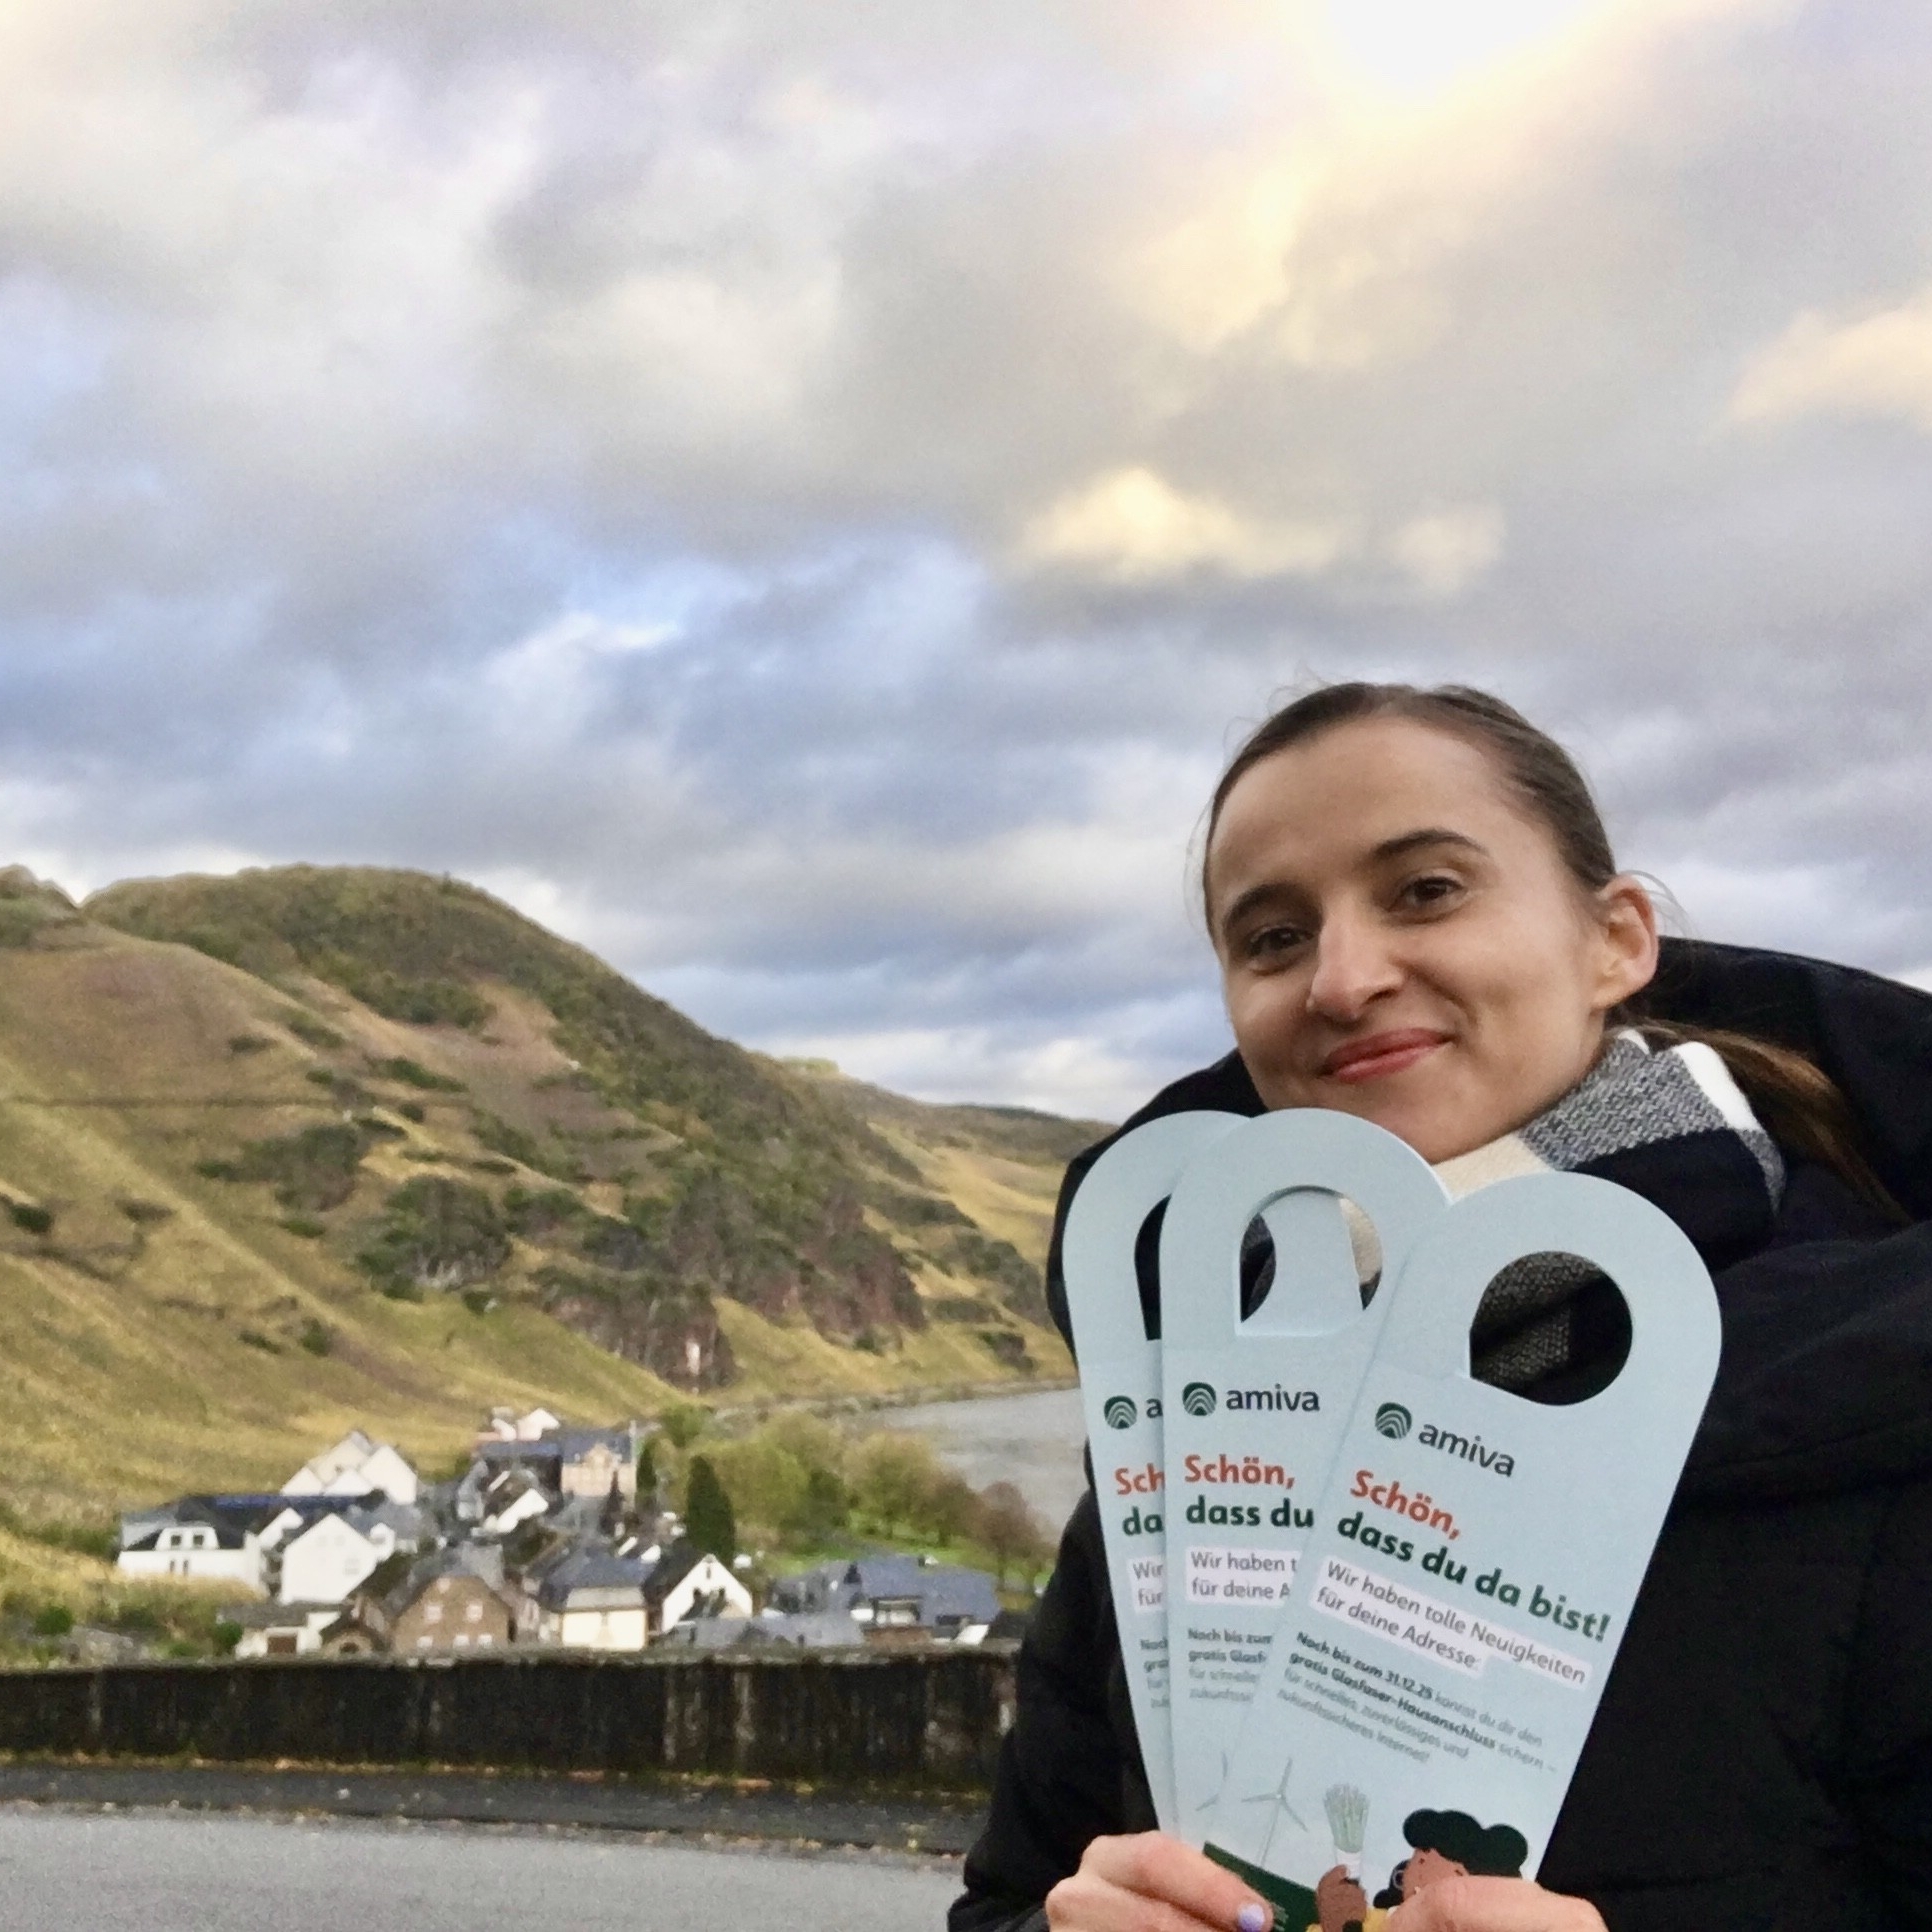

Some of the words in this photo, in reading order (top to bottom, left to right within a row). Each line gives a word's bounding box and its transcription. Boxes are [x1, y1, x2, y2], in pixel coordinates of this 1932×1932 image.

[1226, 1383, 1320, 1412] amiva
[1419, 1424, 1515, 1477] amiva
[1185, 1454, 1295, 1490] Schön,
[1186, 1496, 1261, 1527] dass
[1270, 1498, 1314, 1528] du
[1350, 1470, 1459, 1540] Schön,
[1190, 1551, 1222, 1569] Wir
[1227, 1552, 1285, 1571] haben
[1337, 1512, 1414, 1562] dass
[1421, 1546, 1467, 1584] du
[1475, 1567, 1521, 1606] da
[1528, 1584, 1611, 1642] bist!
[1192, 1577, 1218, 1596] für
[1223, 1580, 1274, 1599] deine
[1317, 1587, 1345, 1611] für
[1348, 1602, 1399, 1635] deine
[1328, 1560, 1358, 1587] Wir
[1362, 1575, 1420, 1615] haben
[1425, 1605, 1466, 1634] tolle
[1470, 1622, 1586, 1684] Neuigkeiten
[1289, 1653, 1328, 1675] gratis
[1297, 1631, 1330, 1654] Noch
[1332, 1646, 1351, 1664] bis
[1354, 1660, 1383, 1678] zum
